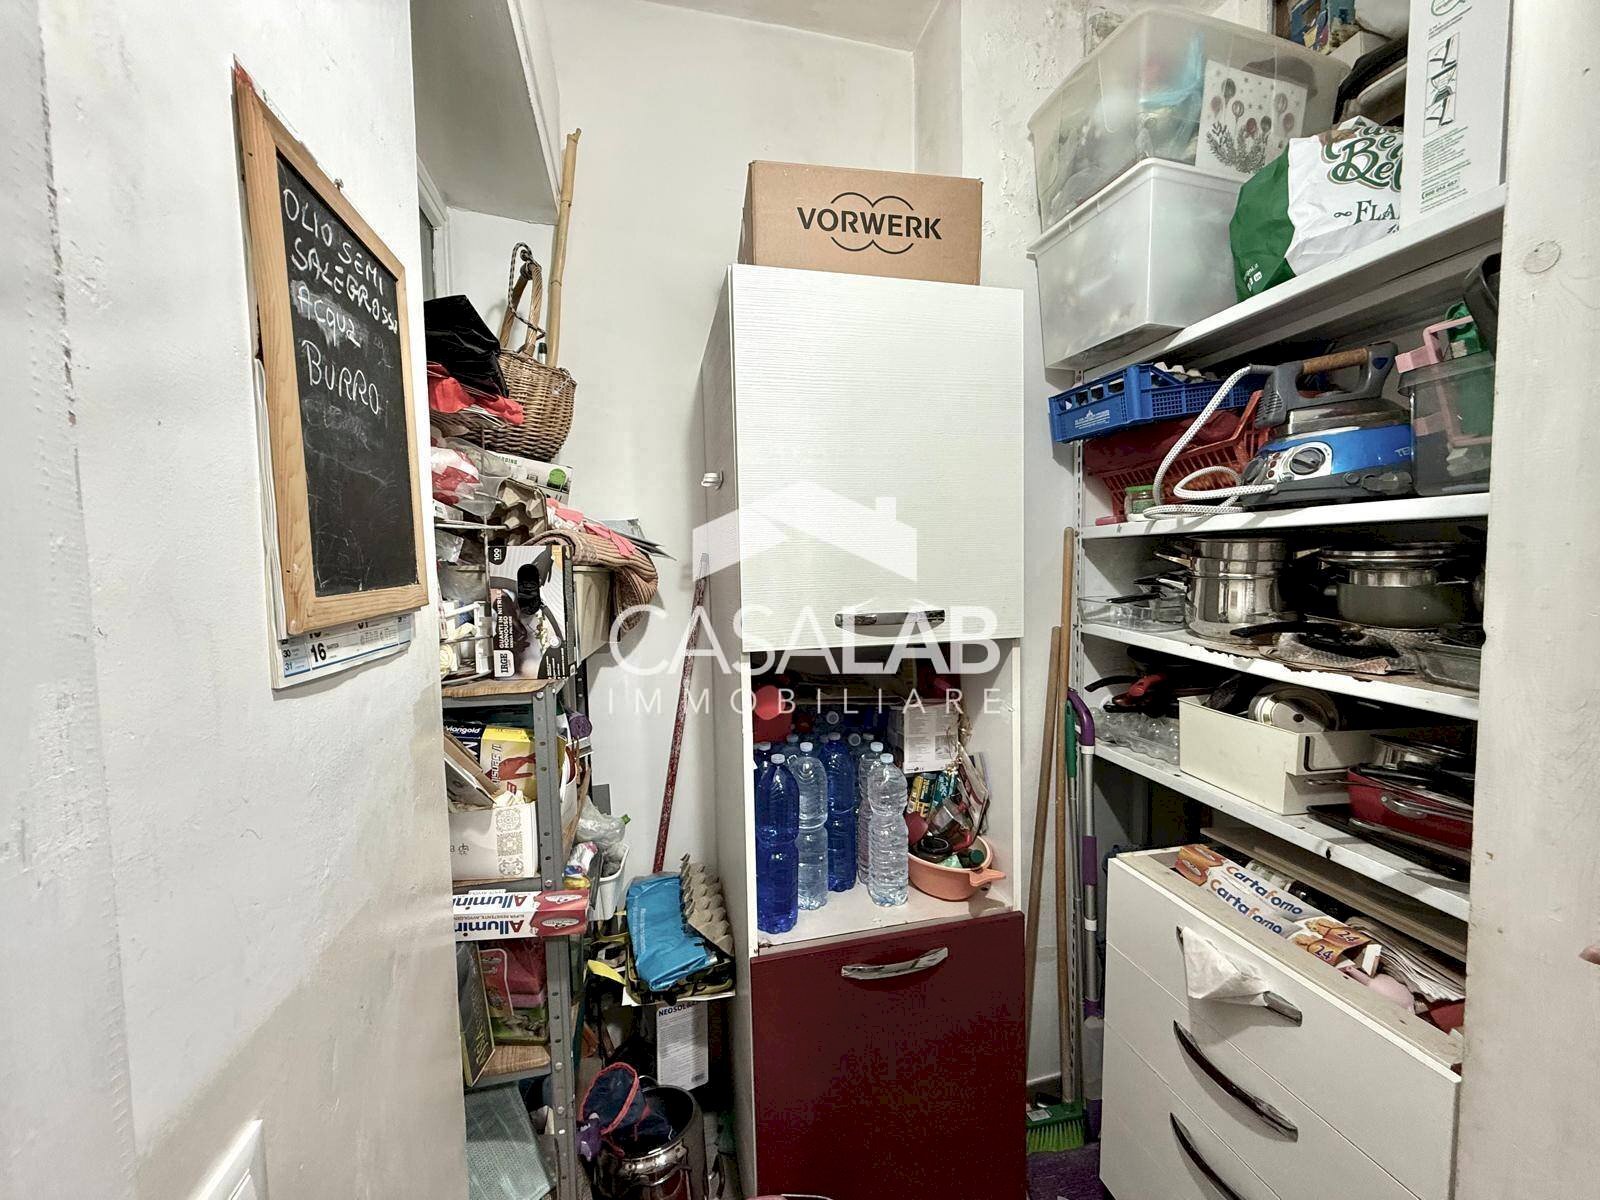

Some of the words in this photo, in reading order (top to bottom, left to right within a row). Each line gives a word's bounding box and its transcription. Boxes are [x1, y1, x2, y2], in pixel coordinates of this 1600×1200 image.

[1353, 200, 1401, 225] FLA
[796, 206, 943, 241] VORWERK
[283, 189, 333, 247] OLIO
[338, 242, 384, 296] SEMI
[310, 643, 327, 662] 16
[284, 662, 293, 671] 31
[500, 653, 509, 673] IRGE
[1337, 930, 1360, 943] 24
[1314, 945, 1334, 961] 24
